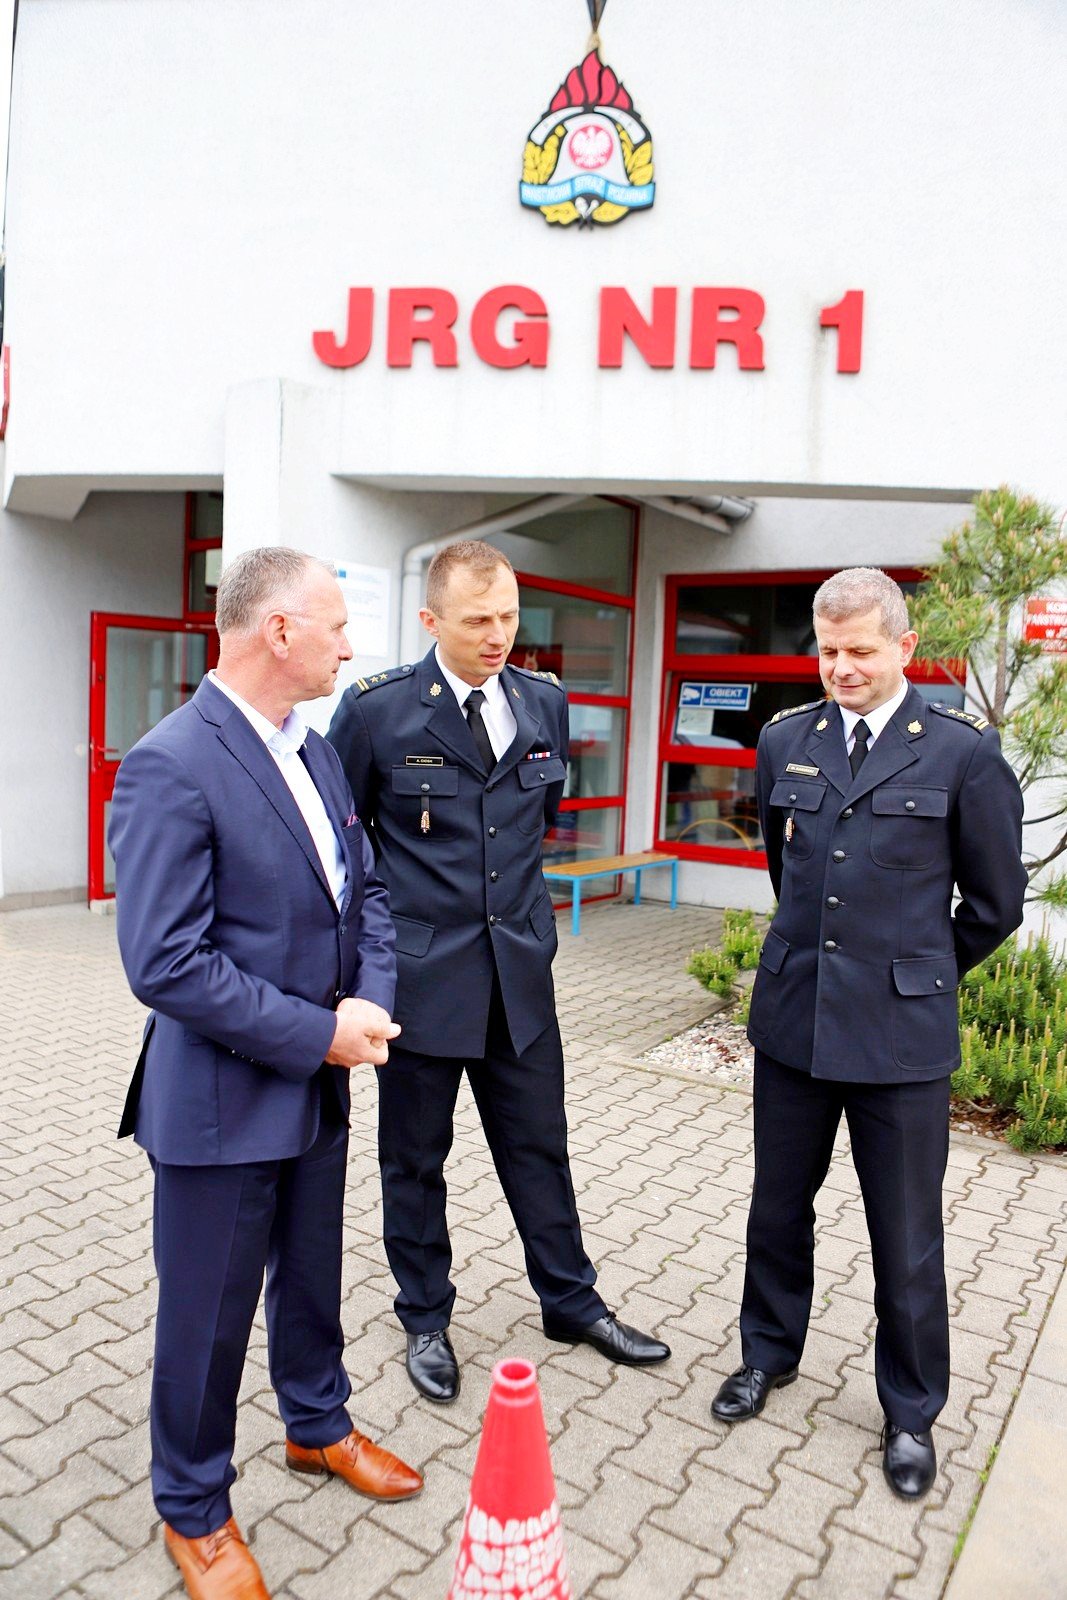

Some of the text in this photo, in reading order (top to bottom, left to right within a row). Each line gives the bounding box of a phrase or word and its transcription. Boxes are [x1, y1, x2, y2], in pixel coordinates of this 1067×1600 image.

[312, 285, 864, 373] JRG NR 1
[709, 688, 743, 697] OBIEKT
